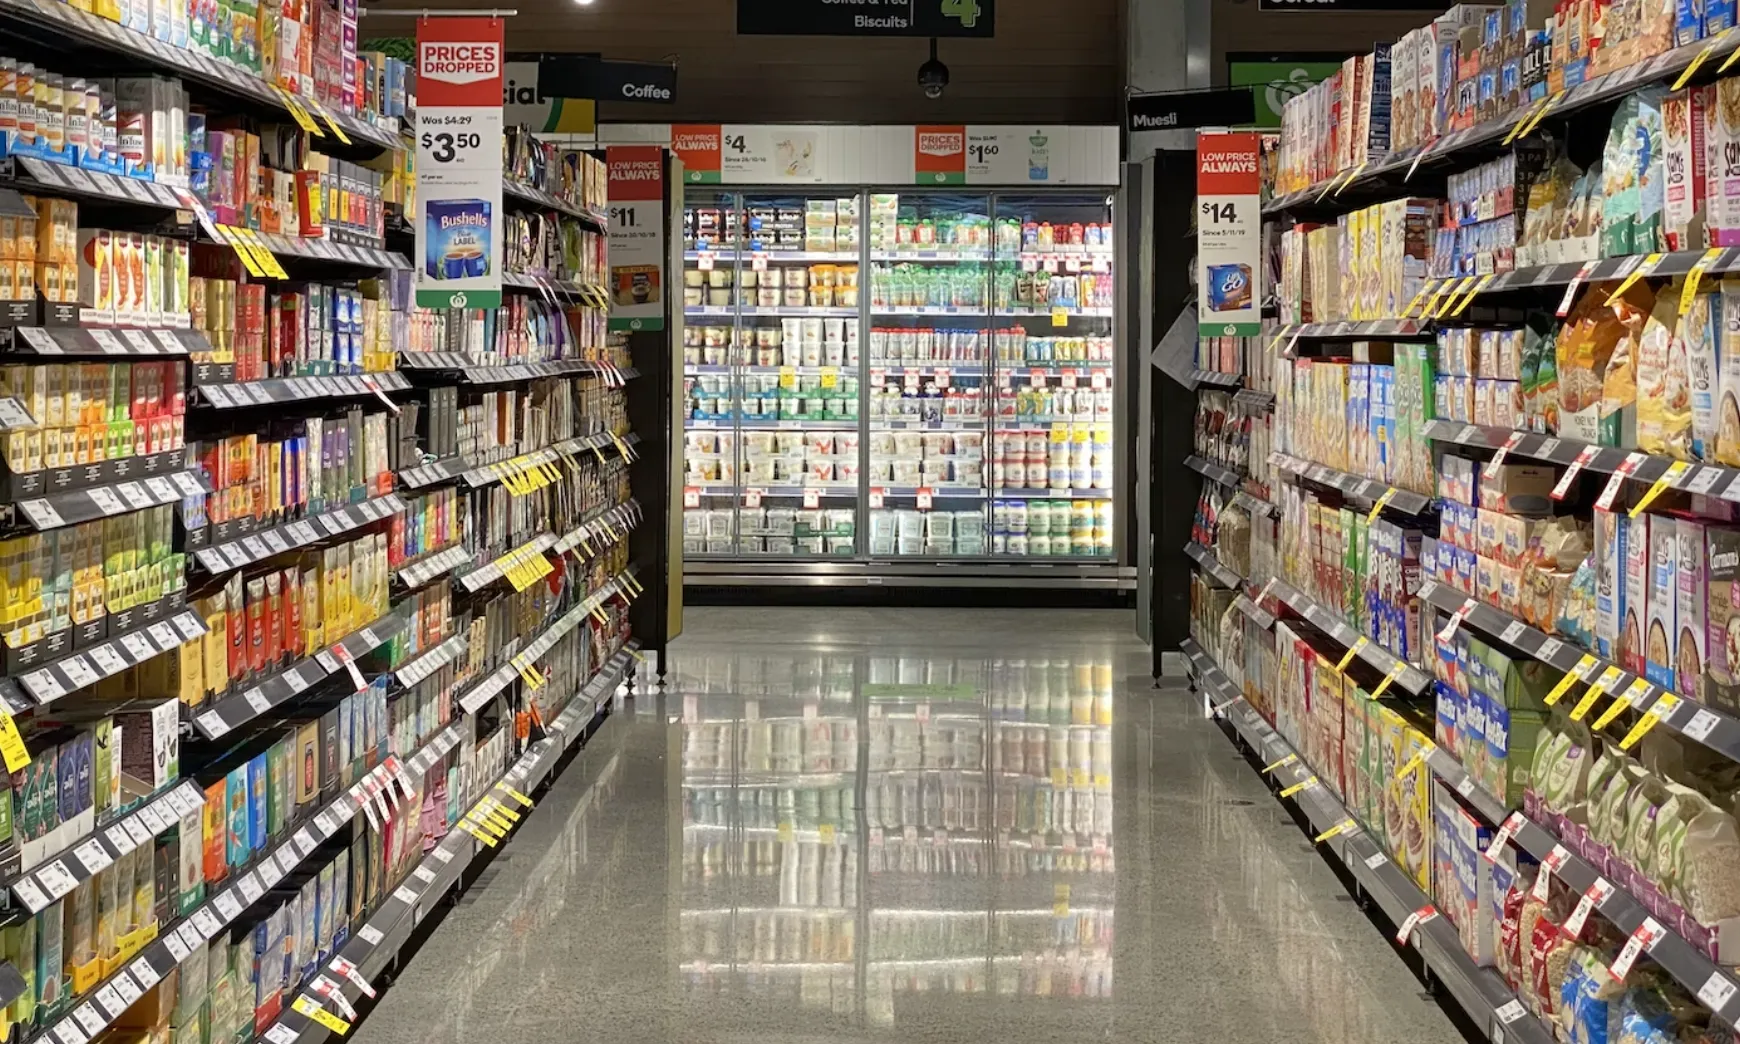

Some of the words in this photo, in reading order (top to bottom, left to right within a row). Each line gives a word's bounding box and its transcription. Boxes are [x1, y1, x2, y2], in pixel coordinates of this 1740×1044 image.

[940, 0, 981, 27] 4
[854, 15, 908, 28] Biscuits
[425, 46, 495, 61] PRICES
[425, 62, 495, 73] DROPPED
[622, 83, 671, 99] Coffee
[421, 116, 443, 125] Was
[1133, 112, 1178, 127] Muesli
[725, 135, 746, 154] $4
[921, 135, 960, 144] PRICES
[675, 141, 718, 151] ALWAYS
[1201, 153, 1225, 162] LOW
[1226, 152, 1256, 161] PRICE
[609, 162, 631, 170] LOW
[632, 161, 660, 170] PRICE
[1201, 162, 1257, 173] ALWAYS
[609, 169, 660, 180] ALWAYS
[610, 207, 635, 227] $11
[1202, 203, 1237, 224] $14
[441, 212, 488, 229] Bushells
[453, 237, 476, 246] LABEL
